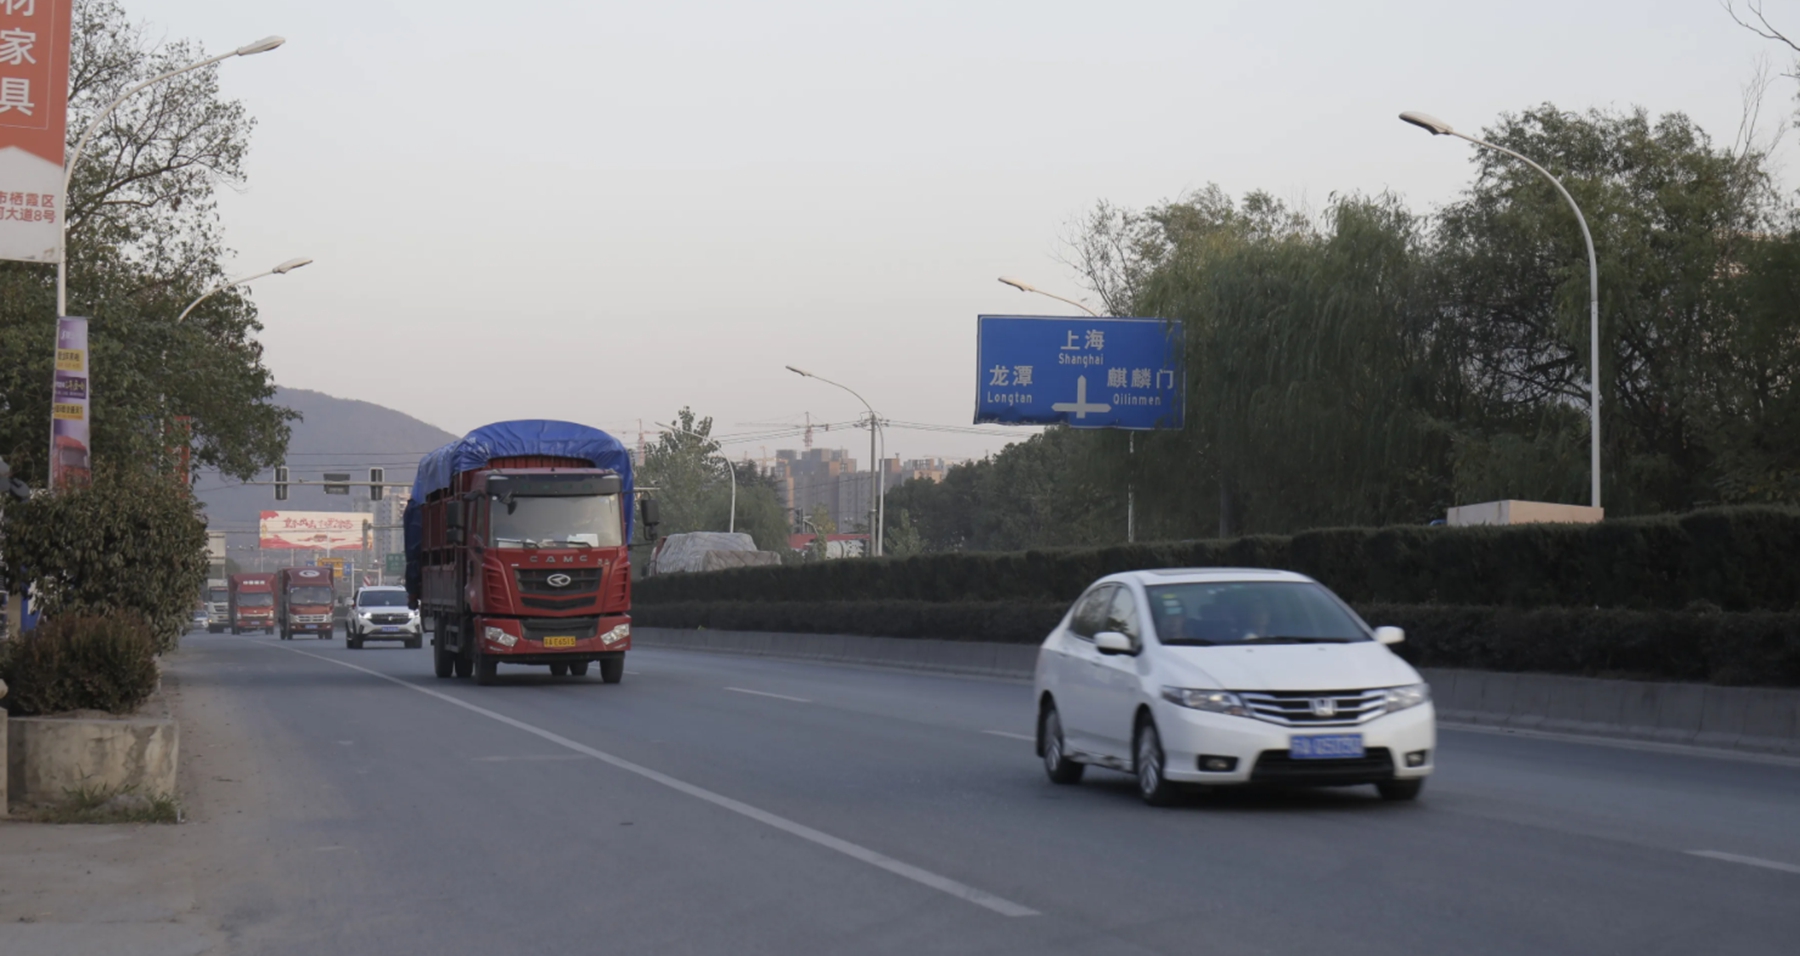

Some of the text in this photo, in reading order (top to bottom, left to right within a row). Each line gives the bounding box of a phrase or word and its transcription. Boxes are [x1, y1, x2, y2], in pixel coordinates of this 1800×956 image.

[1060, 329, 1105, 350] 上海
[1058, 353, 1104, 368] Shanghai
[989, 365, 1033, 387] 龙潭
[1107, 367, 1174, 389] 麒麟门
[987, 391, 1032, 406] Longtan
[530, 555, 588, 563] CAMC
